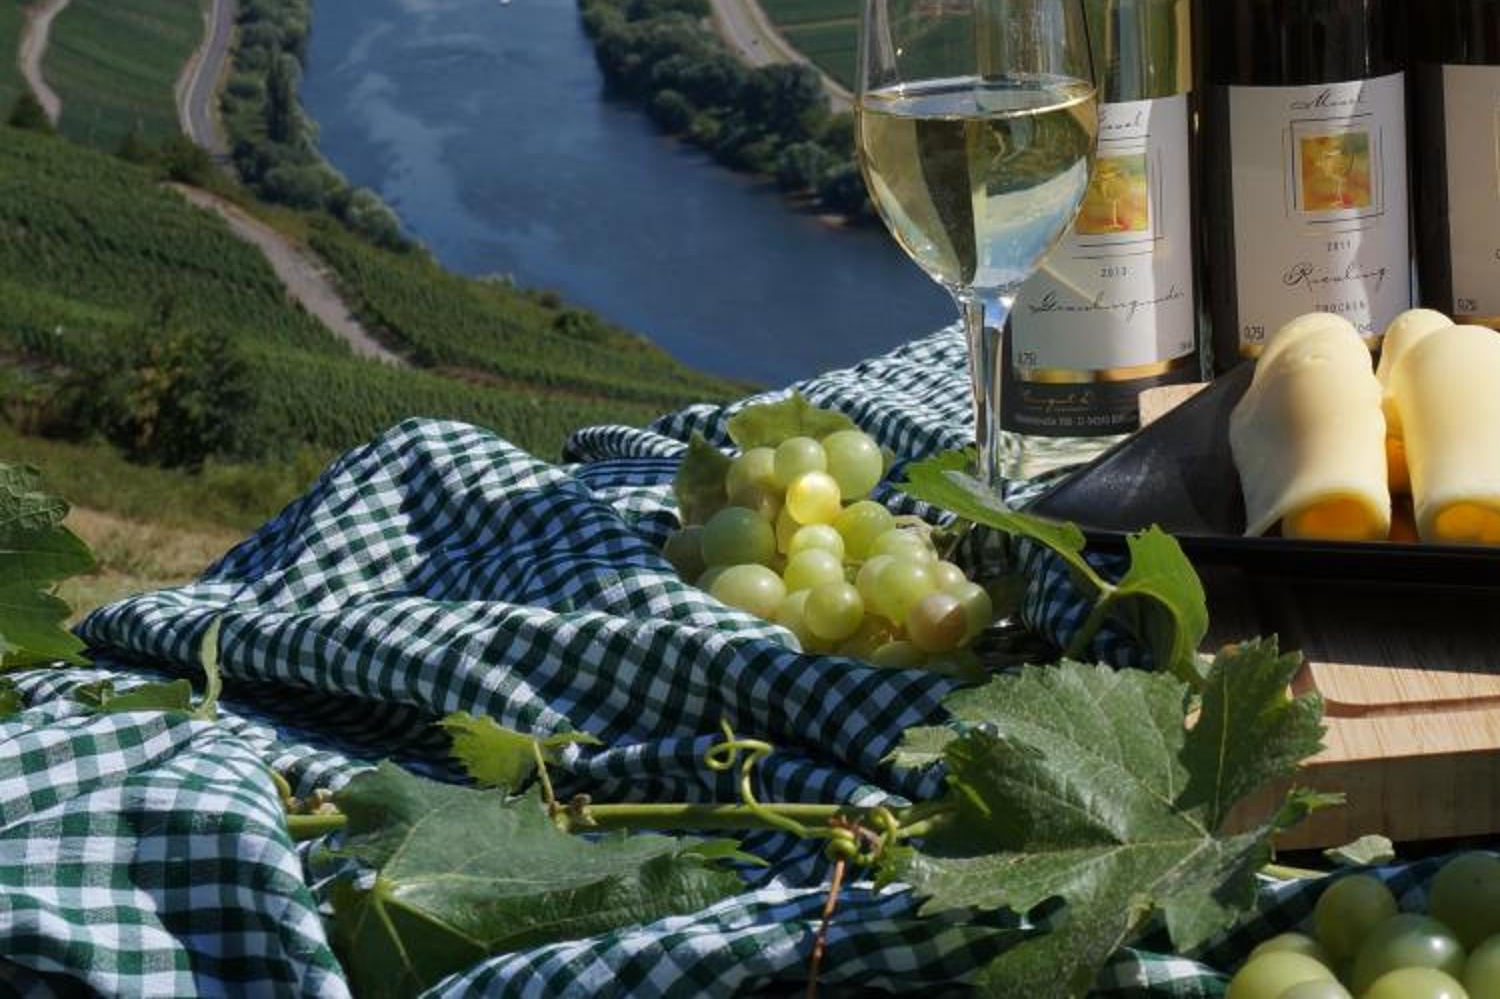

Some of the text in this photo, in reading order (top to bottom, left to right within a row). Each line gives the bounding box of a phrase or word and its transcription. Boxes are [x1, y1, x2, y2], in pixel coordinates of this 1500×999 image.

[1289, 87, 1368, 110] Mosel
[1099, 109, 1142, 130] osel
[1282, 262, 1386, 293] Riesling
